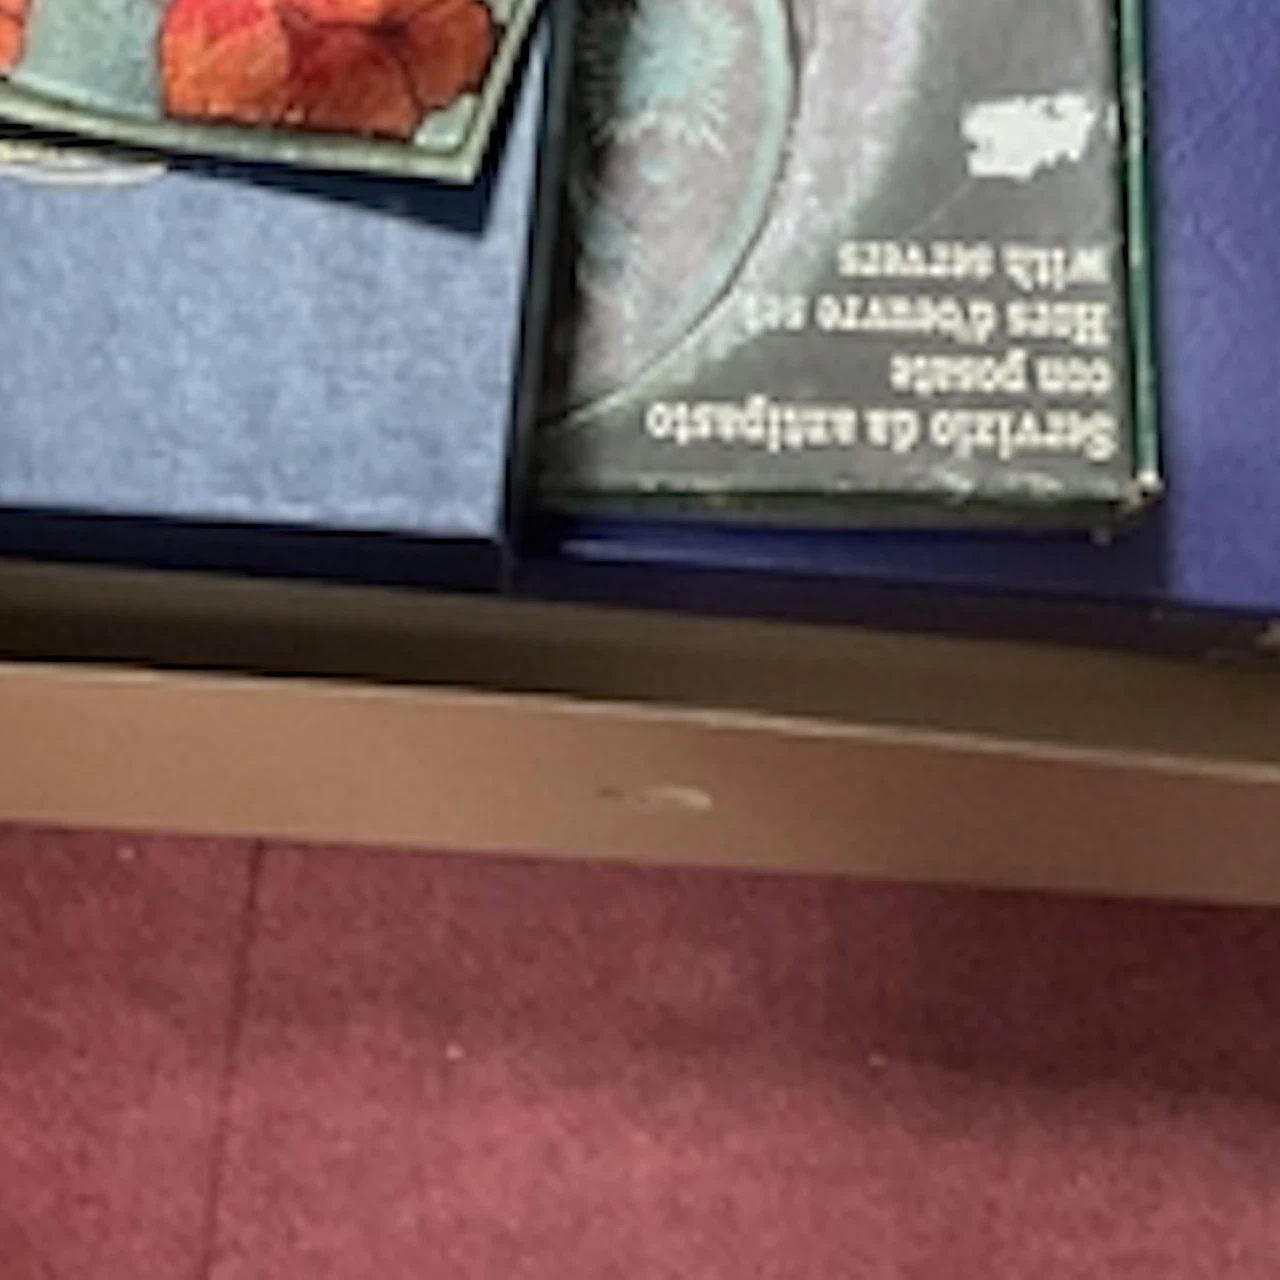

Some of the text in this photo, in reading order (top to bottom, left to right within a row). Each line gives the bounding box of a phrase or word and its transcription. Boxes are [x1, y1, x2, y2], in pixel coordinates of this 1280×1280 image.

[836, 241, 1110, 290] with servers
[1006, 300, 1111, 346] Hors
[890, 348, 1113, 397] con posate
[645, 395, 1118, 462] Servizio da antipasto
